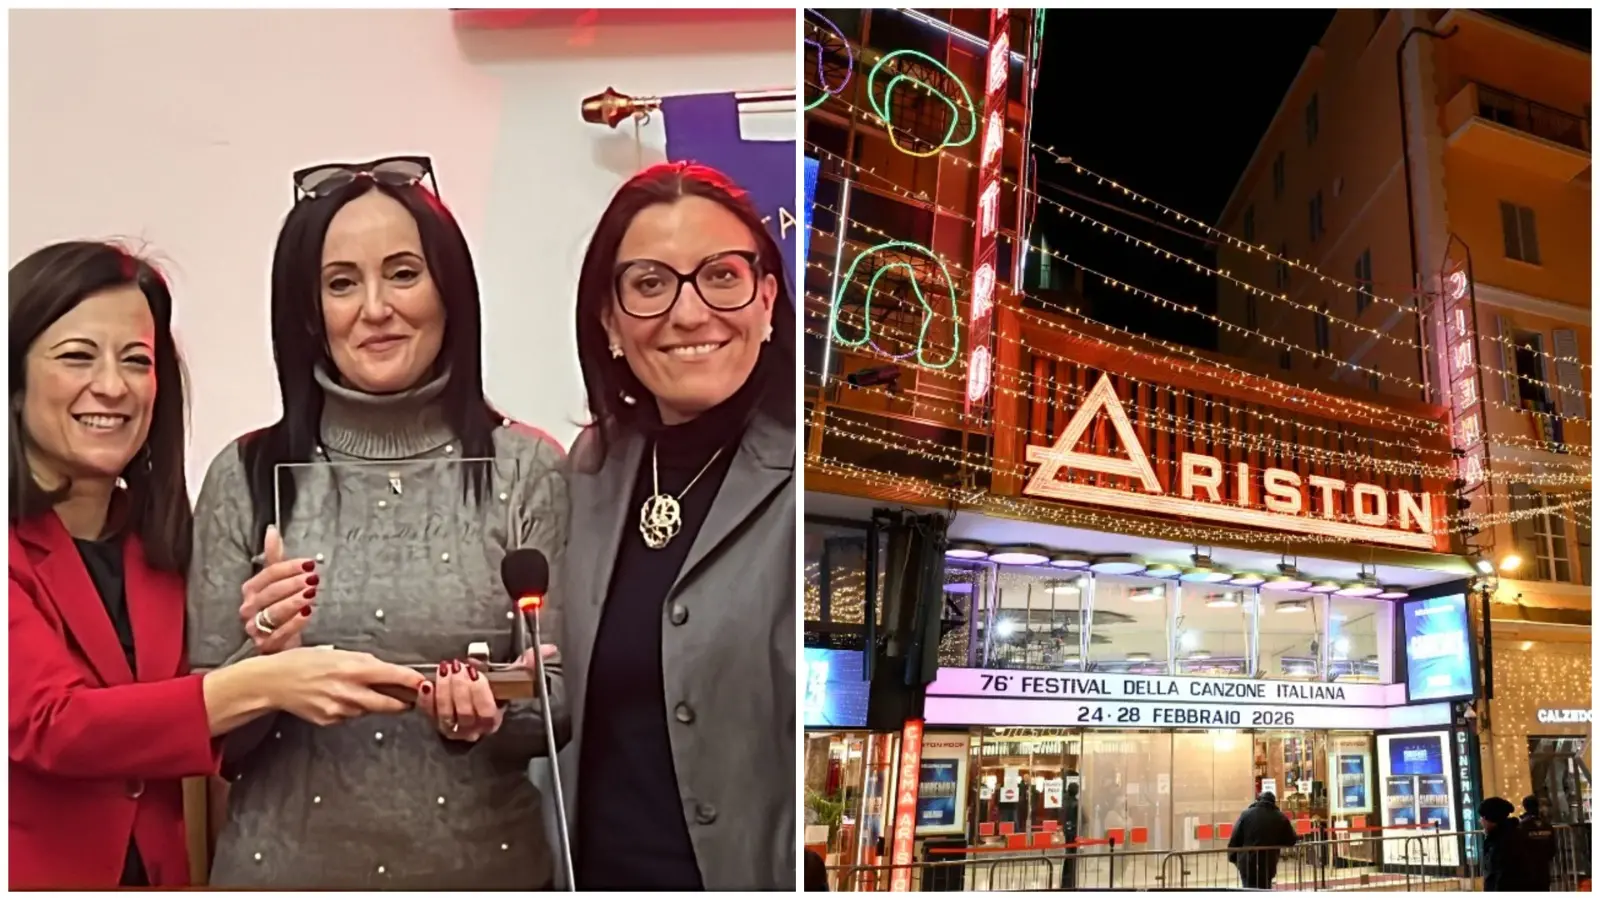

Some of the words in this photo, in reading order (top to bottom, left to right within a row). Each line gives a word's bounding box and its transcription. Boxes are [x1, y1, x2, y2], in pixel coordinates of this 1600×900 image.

[966, 8, 1009, 402] EATRO
[1023, 371, 1438, 549] ARISTON
[1021, 676, 1112, 695] FESTIVAL
[1123, 679, 1179, 696] DELLA
[1190, 681, 1266, 698] CANZONE
[1277, 684, 1346, 700] ITALIANA
[1153, 708, 1241, 725] FEBBRAIO
[1252, 710, 1295, 726] 2026
[903, 726, 919, 804] CINEMA
[1456, 731, 1471, 804] CINEMA
